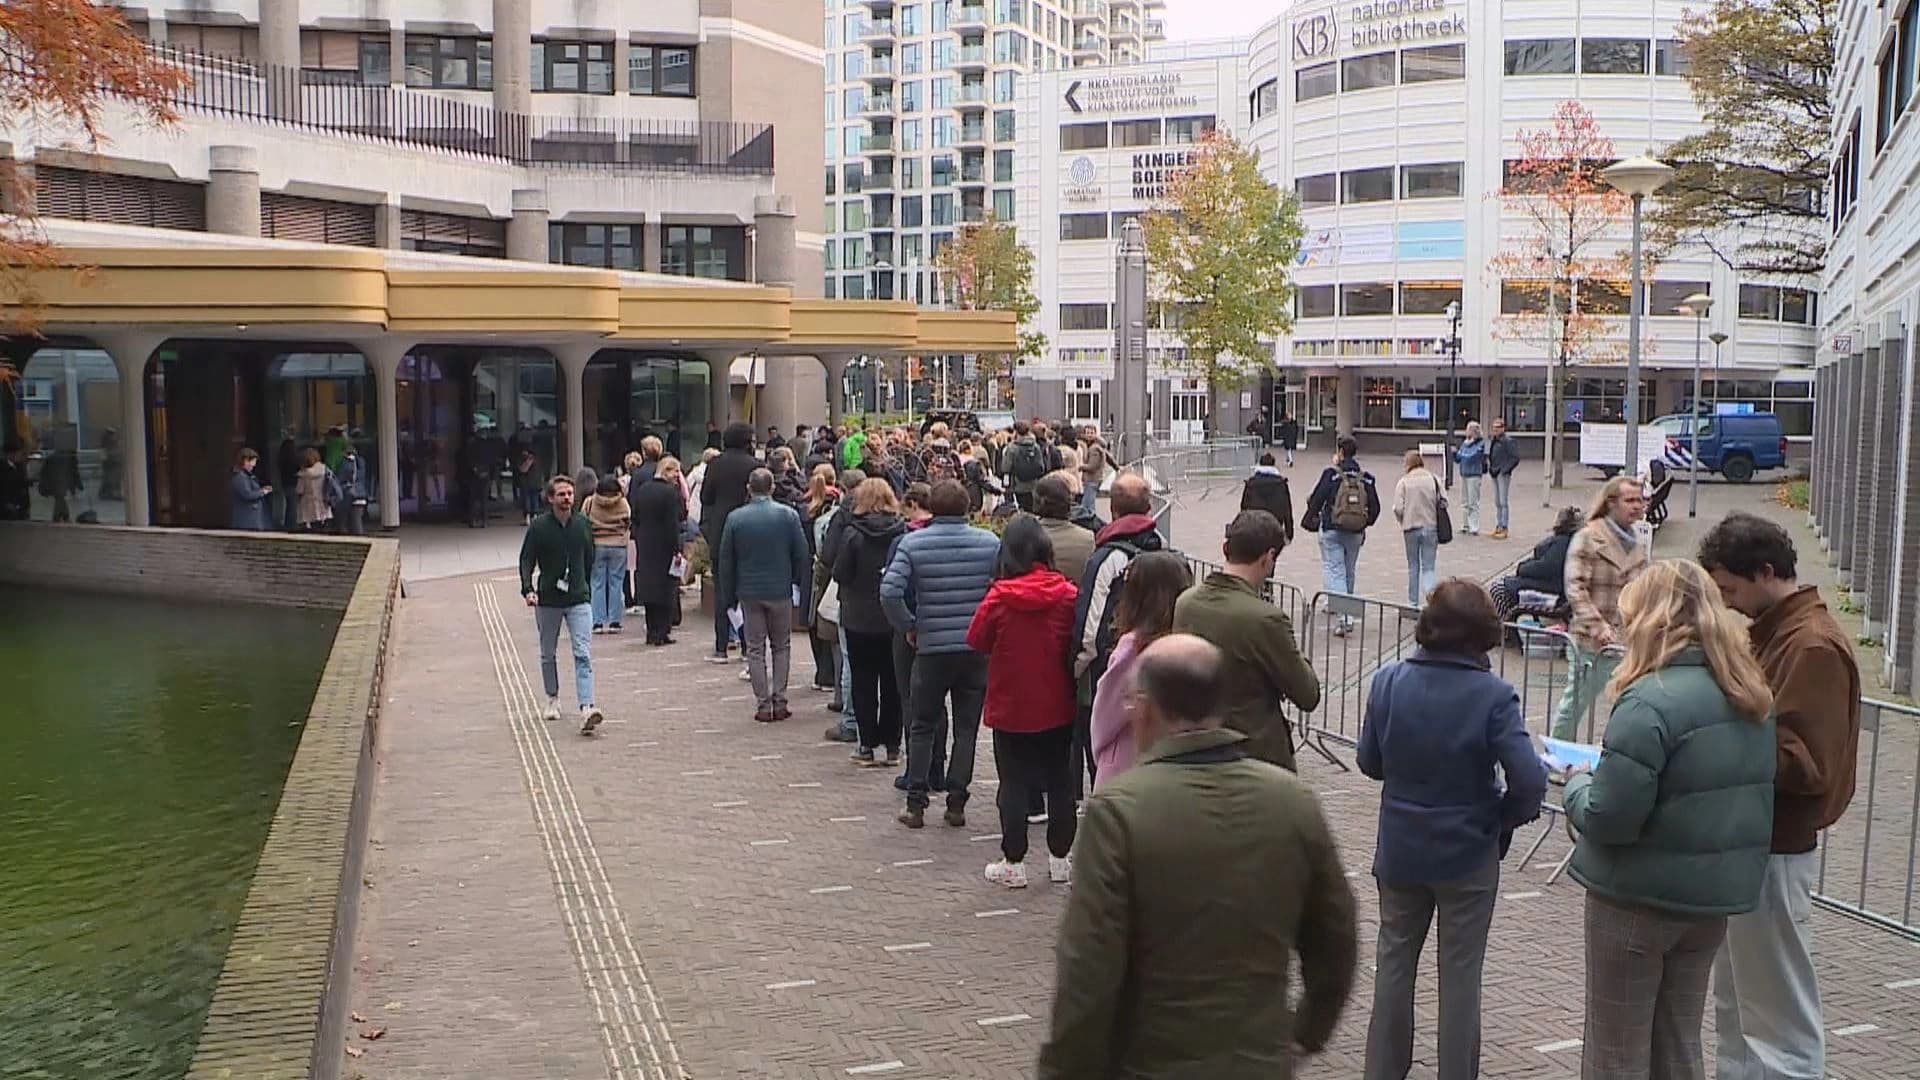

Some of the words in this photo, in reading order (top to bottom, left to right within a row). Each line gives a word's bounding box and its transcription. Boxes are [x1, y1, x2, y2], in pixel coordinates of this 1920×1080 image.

[1292, 14, 1329, 61] KB
[1352, 12, 1466, 48] bibliotheek
[1144, 84, 1175, 96] VOOR
[1132, 169, 1187, 185] BOEK
